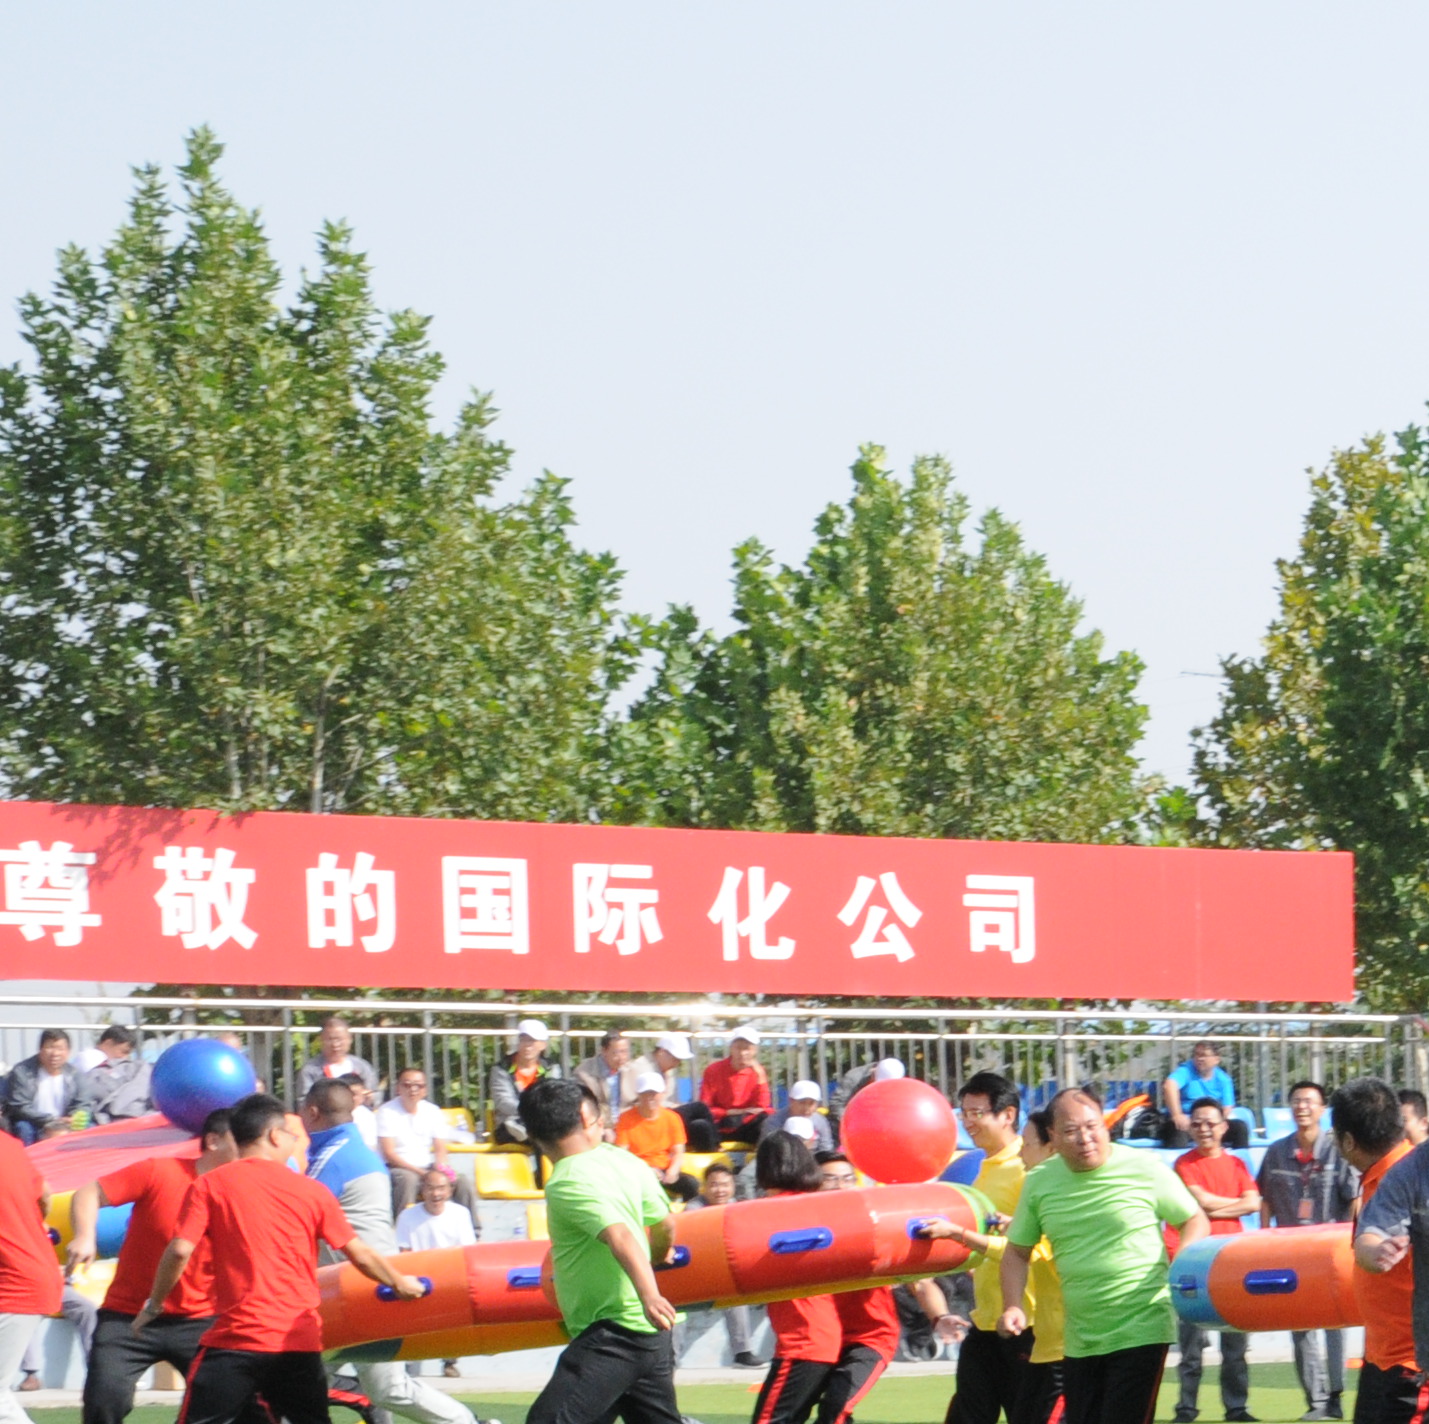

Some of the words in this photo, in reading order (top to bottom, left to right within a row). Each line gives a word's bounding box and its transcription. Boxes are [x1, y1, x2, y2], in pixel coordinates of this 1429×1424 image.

[0, 840, 1036, 963] 尊敬的国际化公司
